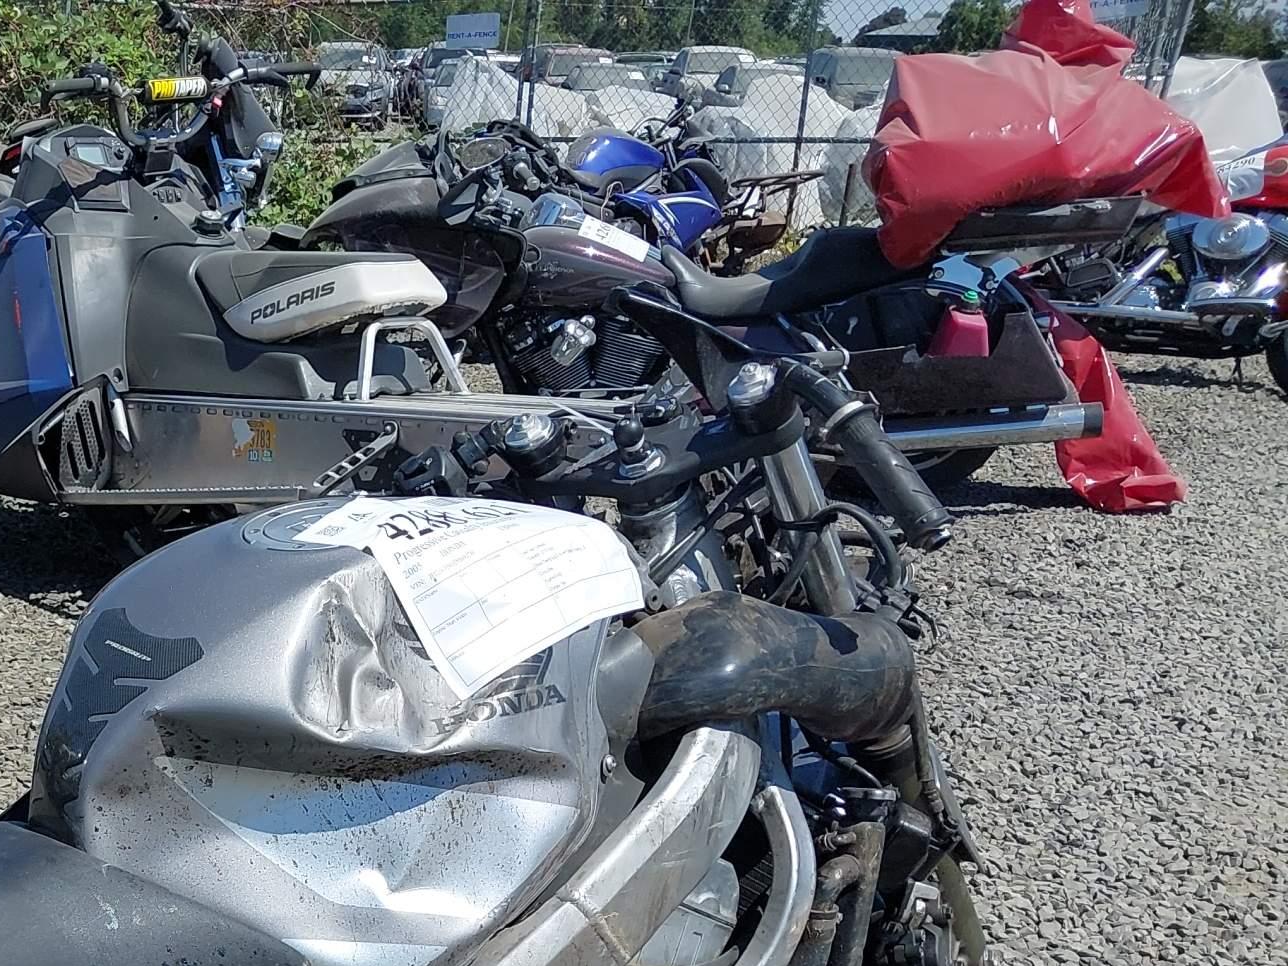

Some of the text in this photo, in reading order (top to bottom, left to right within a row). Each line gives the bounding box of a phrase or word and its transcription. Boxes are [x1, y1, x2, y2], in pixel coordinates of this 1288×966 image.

[448, 31, 497, 39] RENT-A-FENCE
[153, 78, 206, 98] PROTAPER
[250, 281, 336, 325] POLARIS
[393, 532, 446, 566] Progressive
[431, 683, 566, 736] HONDA
